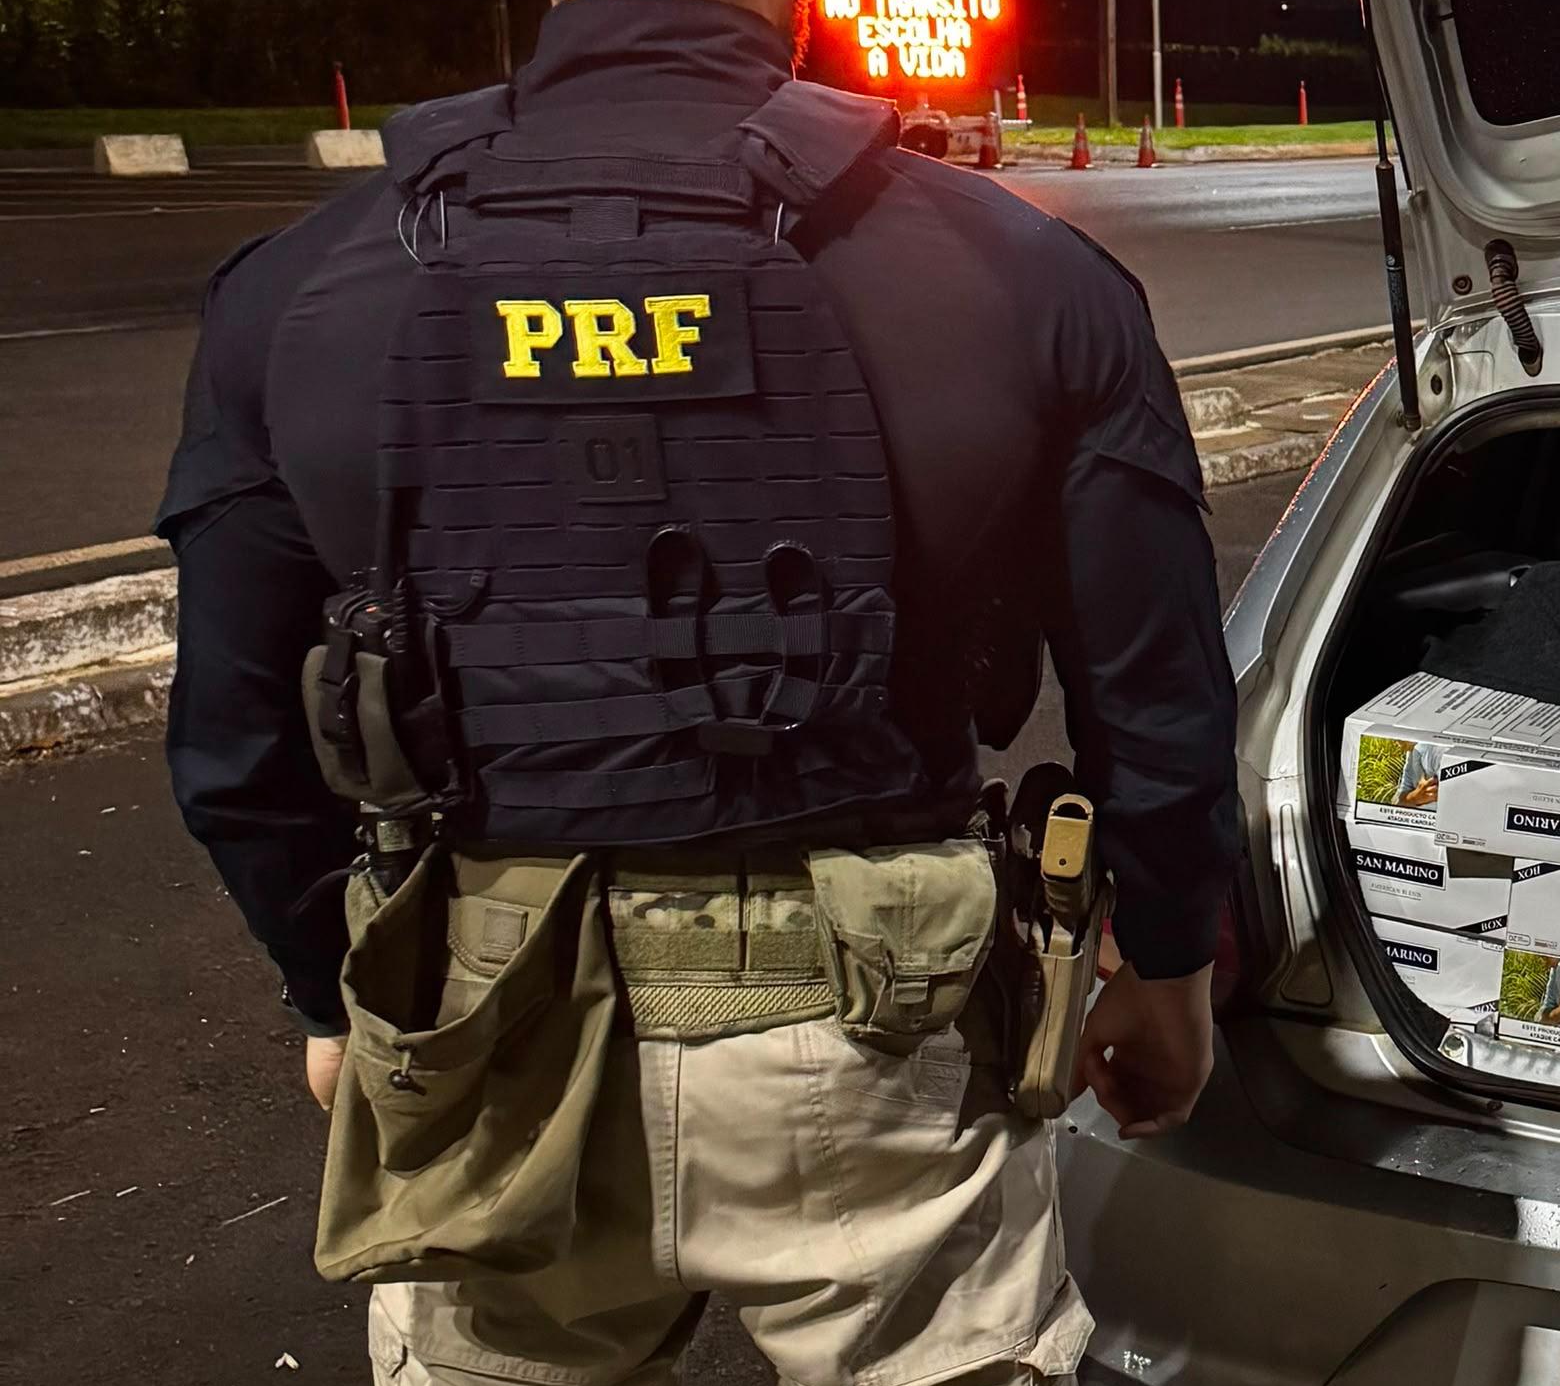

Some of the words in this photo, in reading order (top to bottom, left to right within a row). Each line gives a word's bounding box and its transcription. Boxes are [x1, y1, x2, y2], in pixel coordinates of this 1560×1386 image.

[857, 17, 971, 48] ESCOLHA
[867, 47, 888, 78] A
[899, 47, 966, 78] VIDA
[496, 294, 711, 379] PRF
[584, 438, 645, 484] 01
[1445, 763, 1467, 778] BOX
[1356, 854, 1383, 869] SAN
[1385, 862, 1439, 880] MARINO
[1481, 918, 1503, 932] BOX
